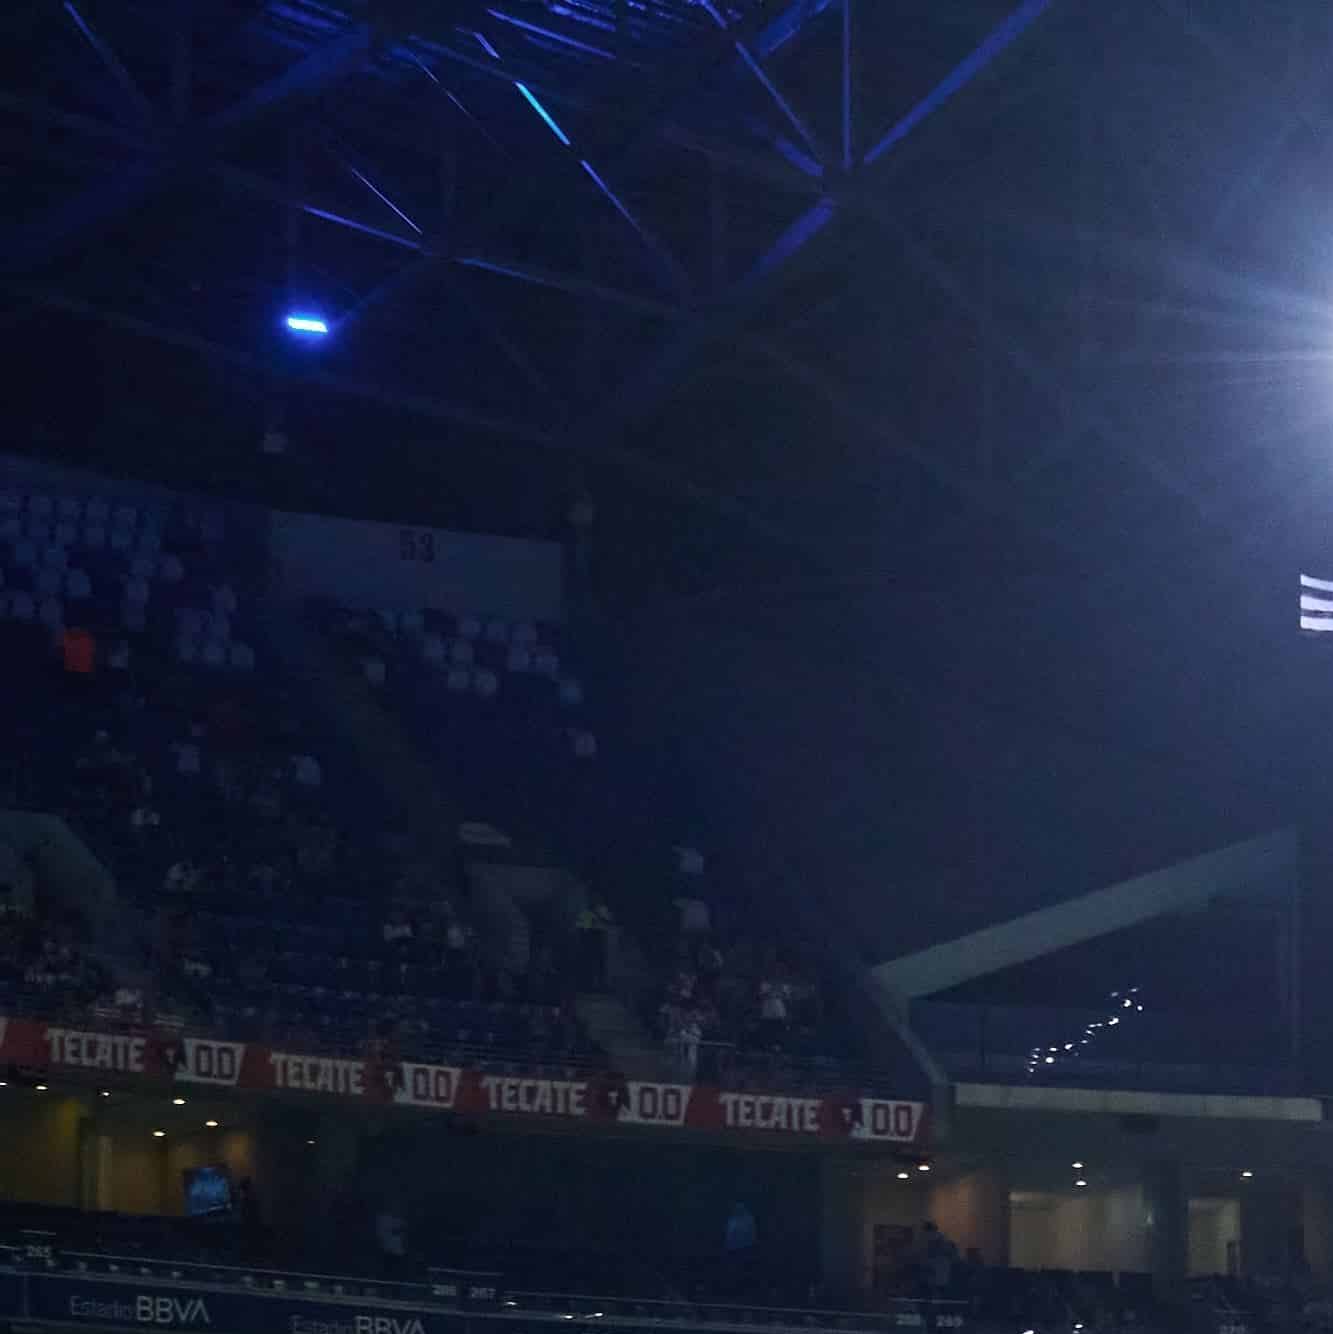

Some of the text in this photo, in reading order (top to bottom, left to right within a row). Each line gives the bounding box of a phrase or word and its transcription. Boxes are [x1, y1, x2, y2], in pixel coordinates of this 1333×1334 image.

[47, 1027, 148, 1073] TECATE
[270, 1049, 367, 1094] TECATE
[484, 1076, 589, 1115] TECATE
[719, 1093, 822, 1131] TECATE
[136, 1295, 212, 1324] BBVA
